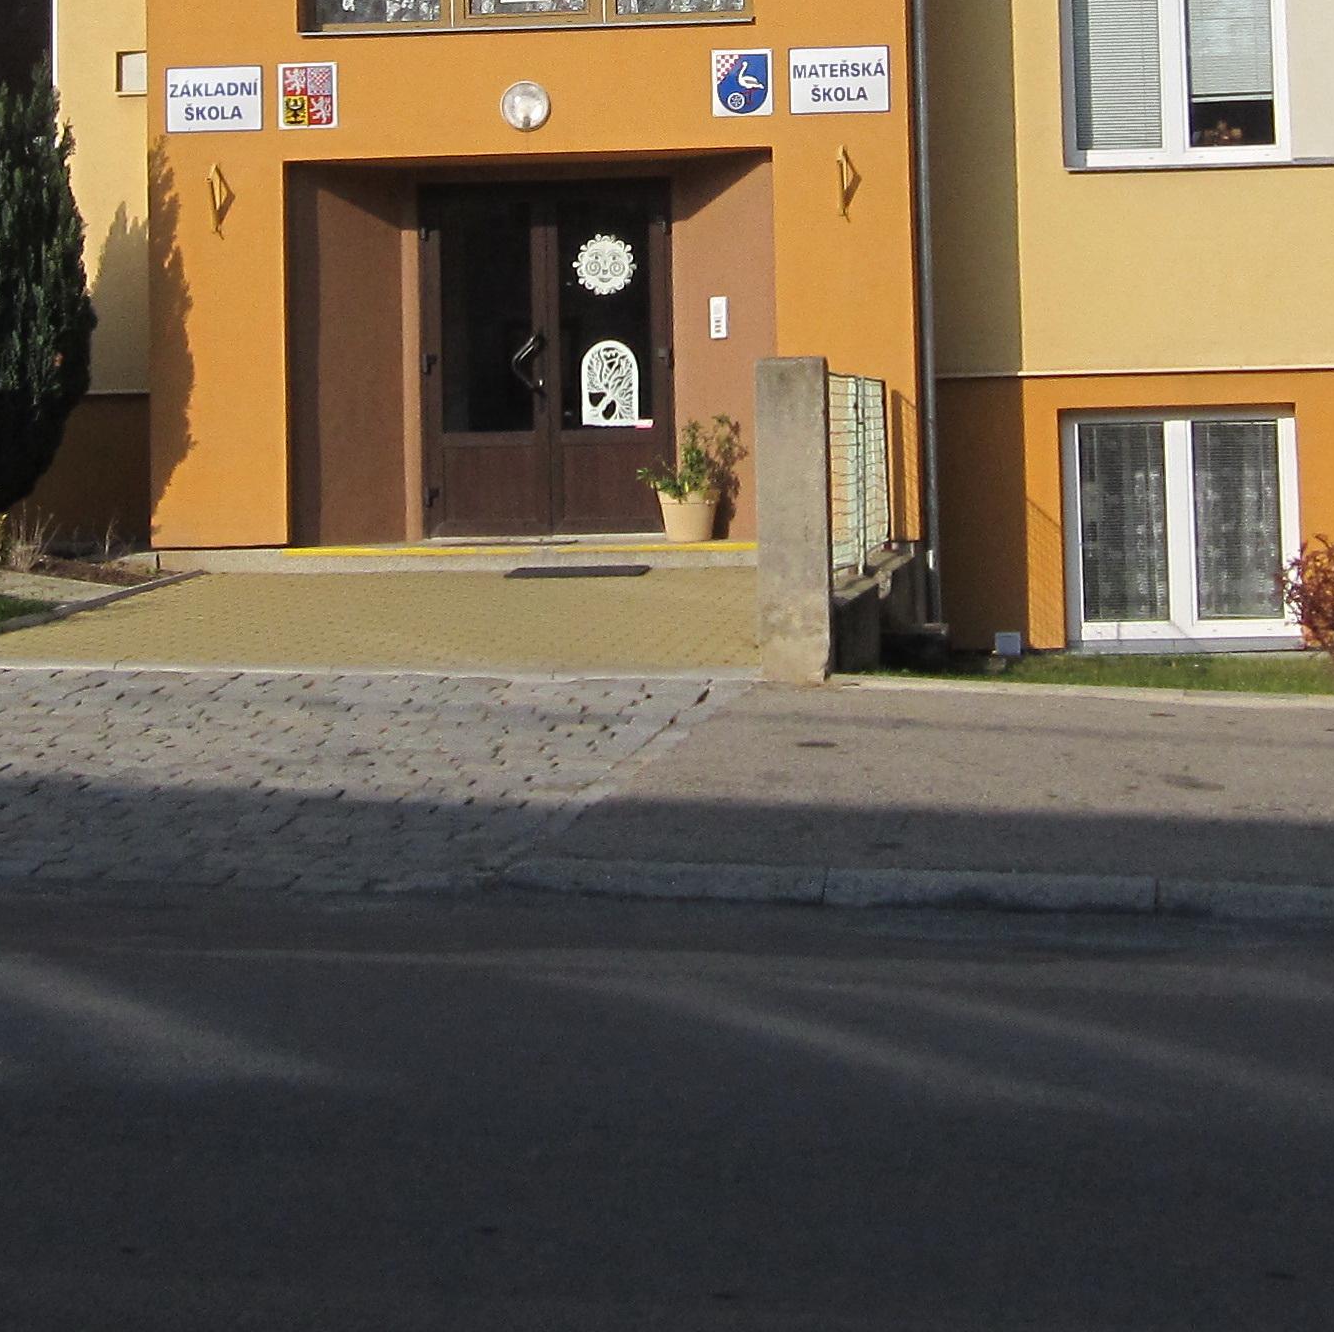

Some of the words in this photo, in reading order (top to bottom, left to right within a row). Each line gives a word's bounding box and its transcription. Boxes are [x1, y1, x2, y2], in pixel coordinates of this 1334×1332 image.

[792, 58, 886, 79] MATEŘSKÁ
[169, 78, 258, 99] ZÁKLADNÍ
[810, 84, 868, 102] ŠKOLA
[184, 103, 243, 121] ŠKOLA
